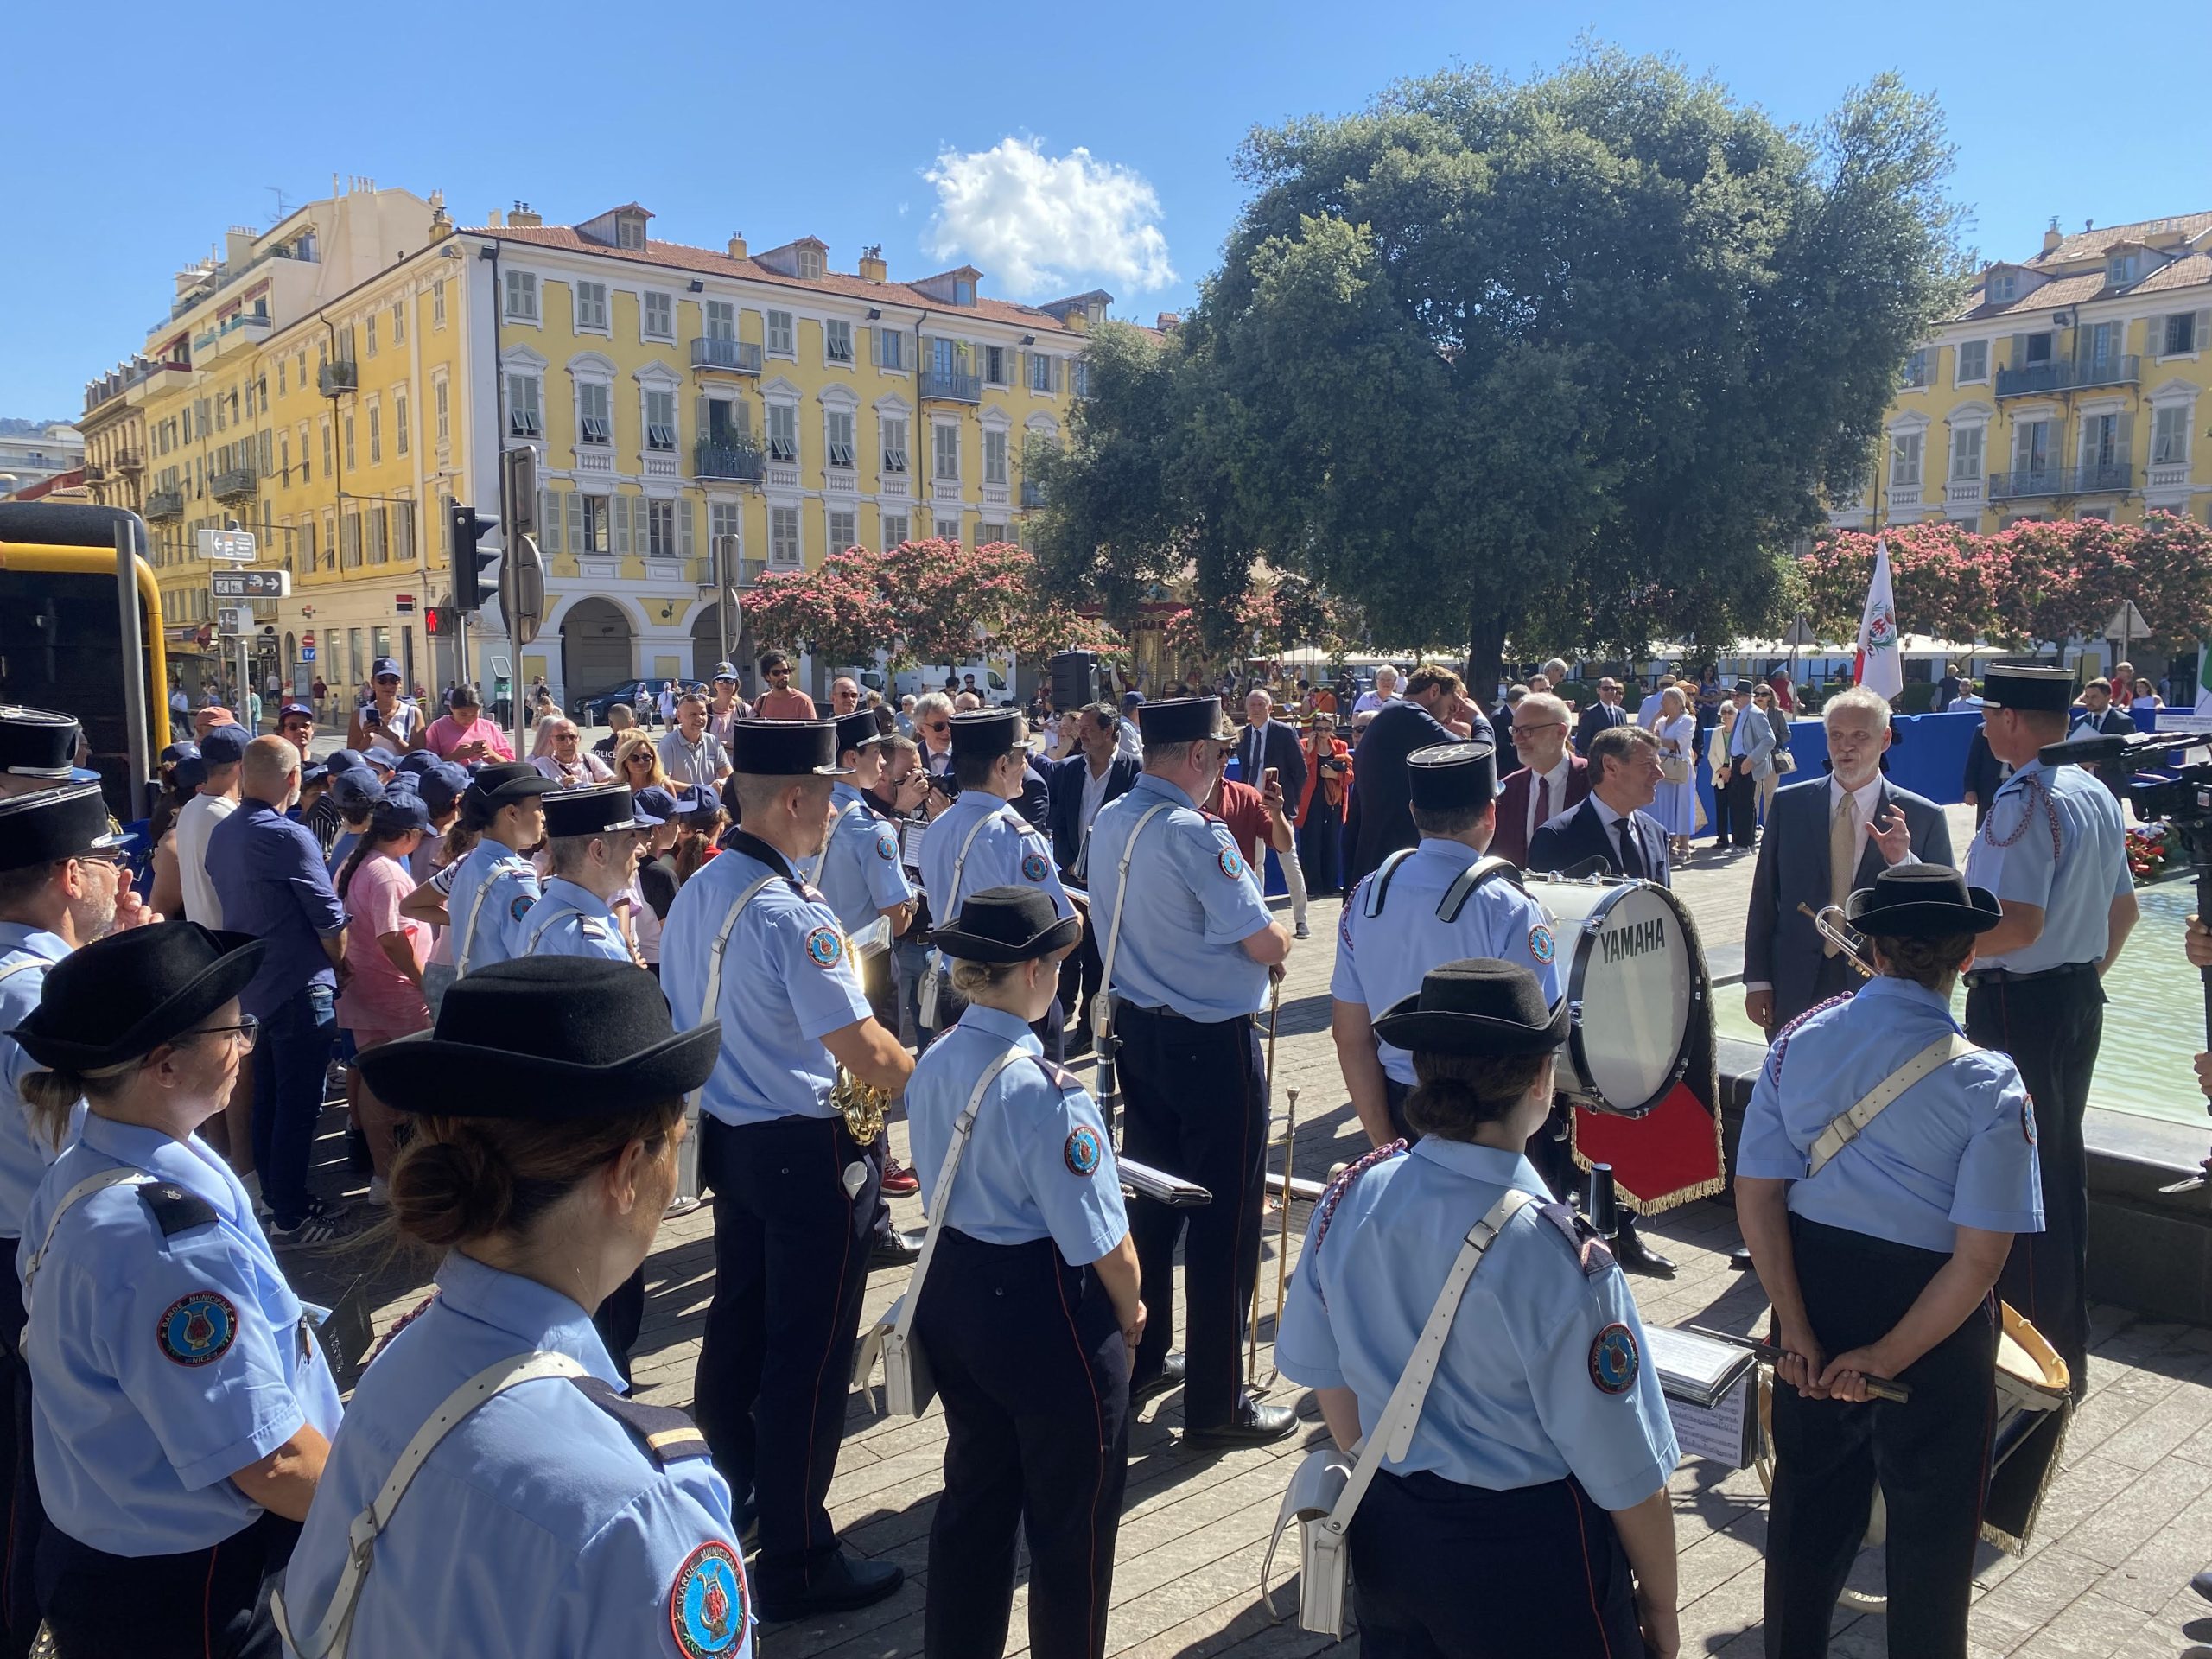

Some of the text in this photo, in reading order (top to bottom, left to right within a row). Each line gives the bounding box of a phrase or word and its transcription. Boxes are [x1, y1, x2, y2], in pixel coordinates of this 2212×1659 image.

[1600, 918, 1665, 964] YAMAHA
[162, 1294, 232, 1328] GARDE MUNICIPALE
[676, 1545, 740, 1605] GARDE MUNICIPALE
